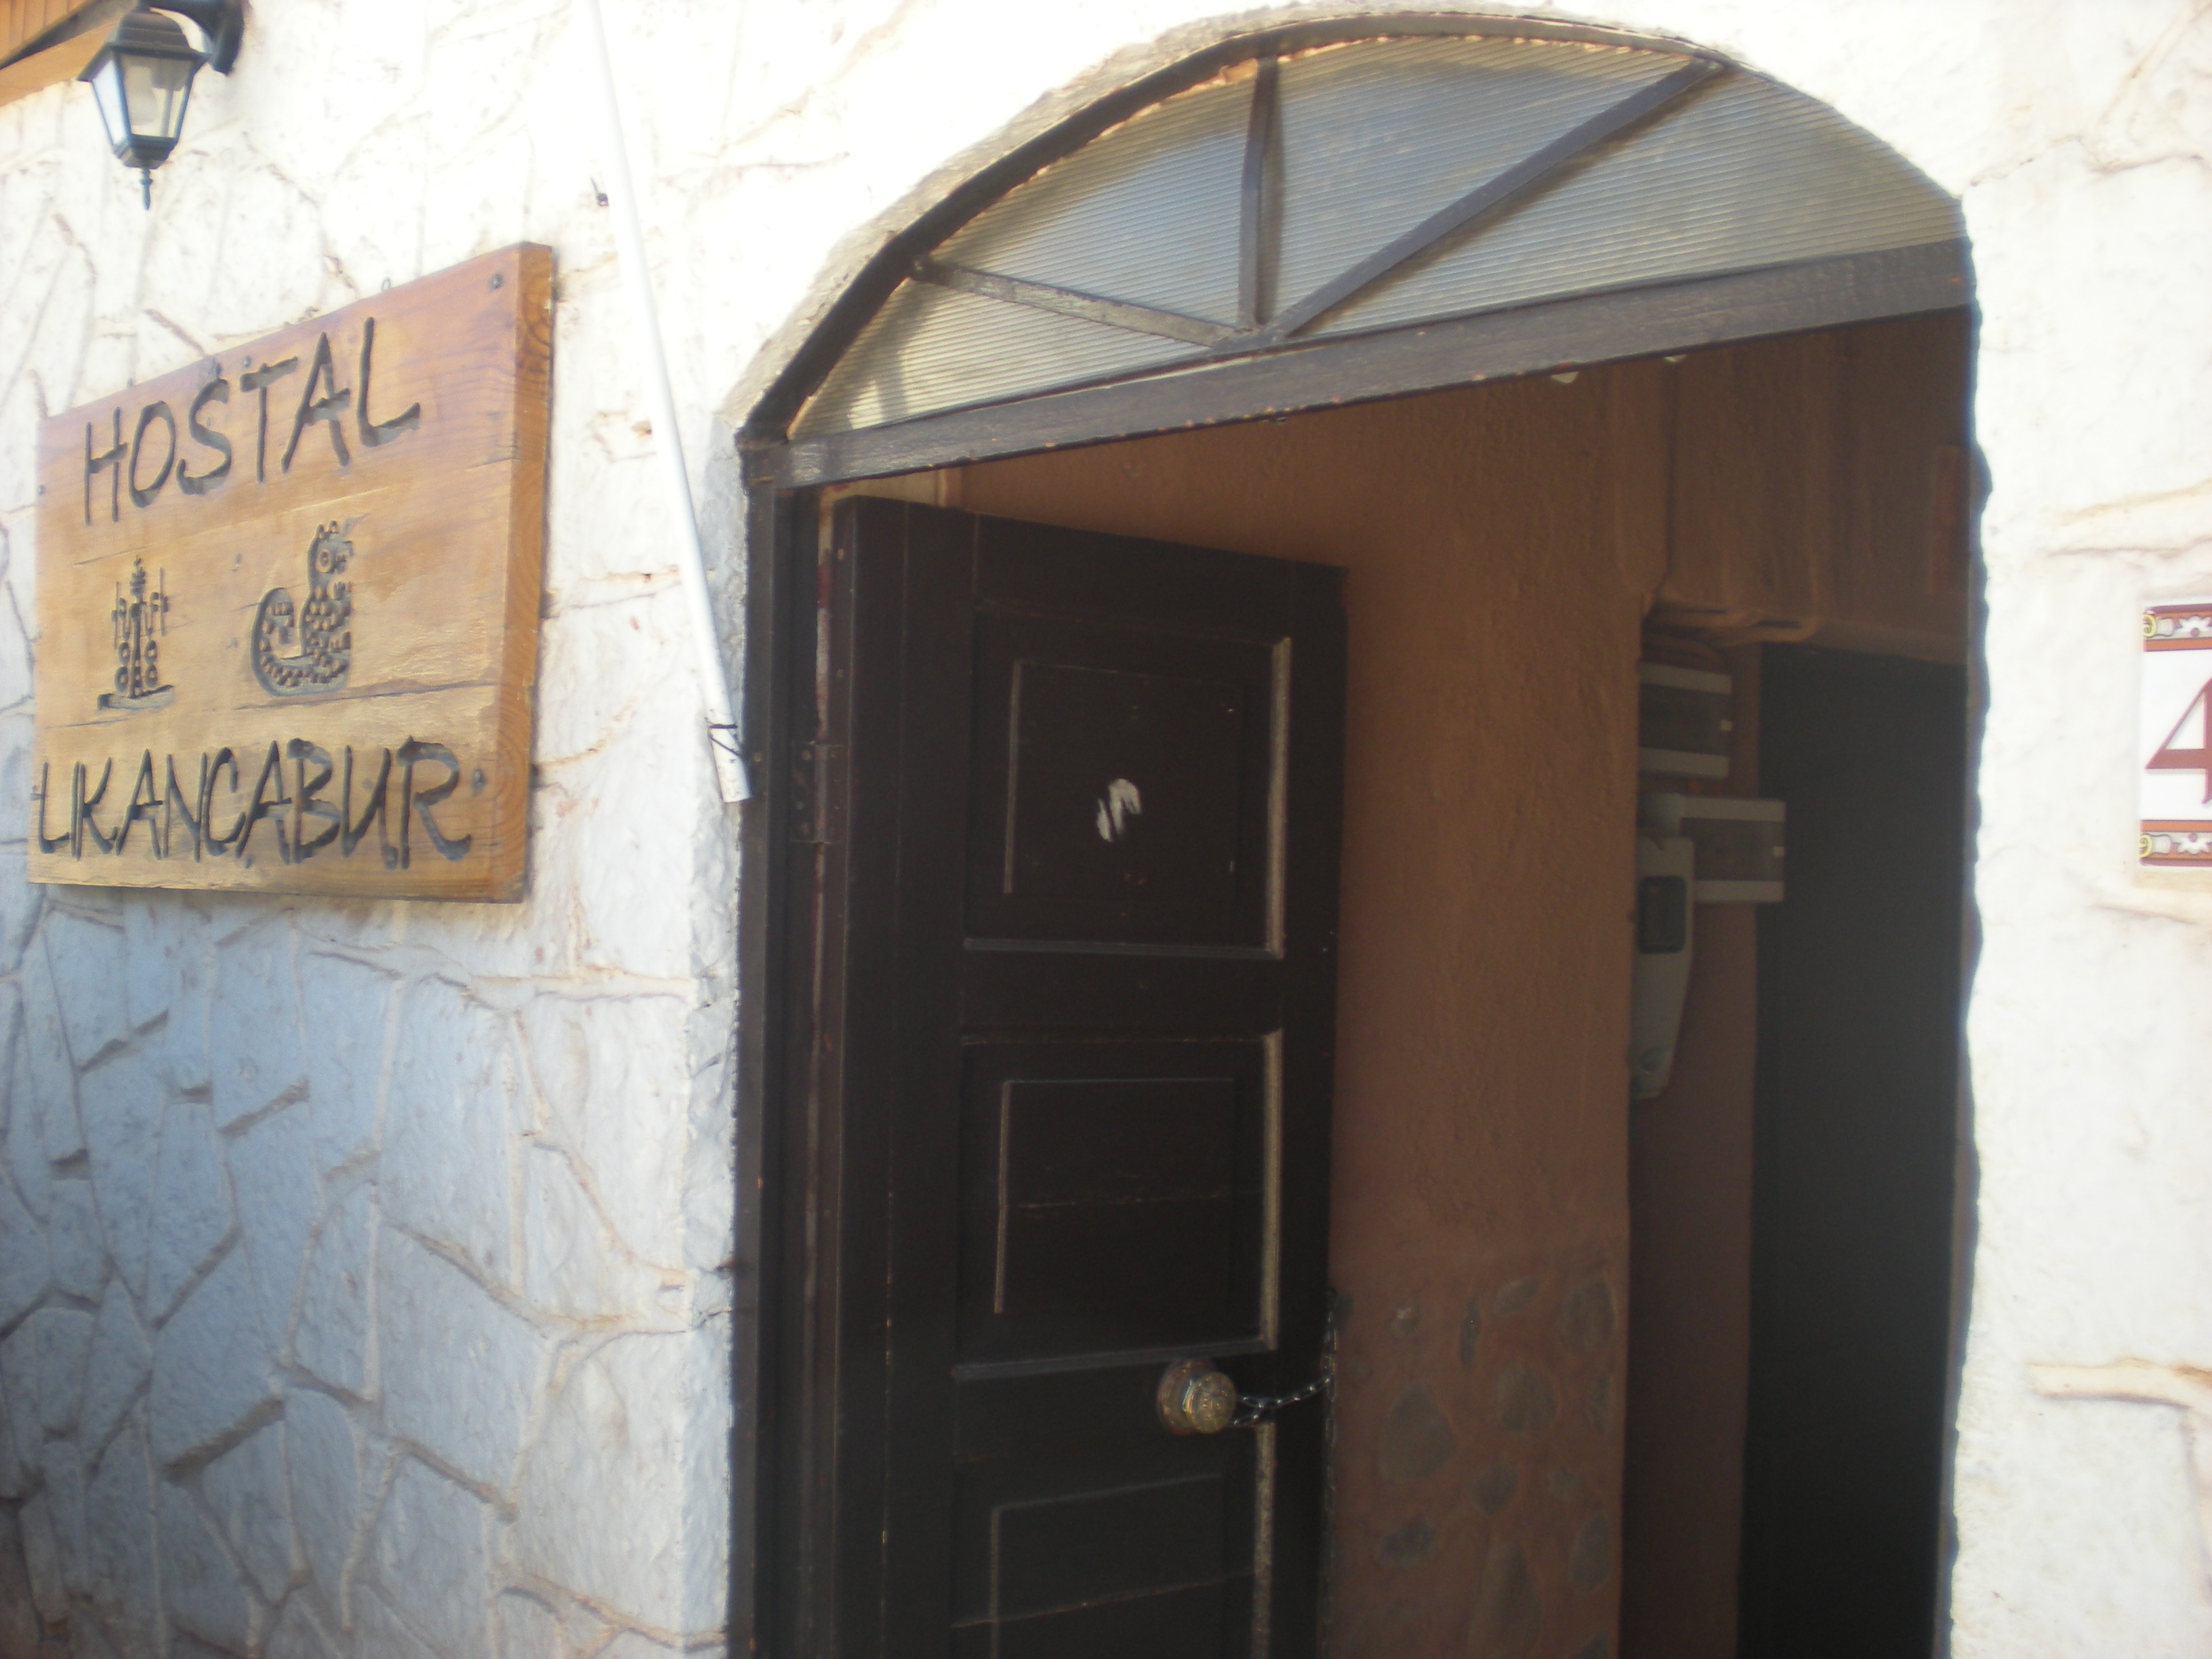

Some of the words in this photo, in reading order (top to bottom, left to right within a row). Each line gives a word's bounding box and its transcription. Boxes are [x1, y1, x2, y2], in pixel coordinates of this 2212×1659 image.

[84, 316, 422, 525] HOSTAL
[31, 736, 472, 869] LIKANCABUR
[2145, 677, 2212, 804] 4
